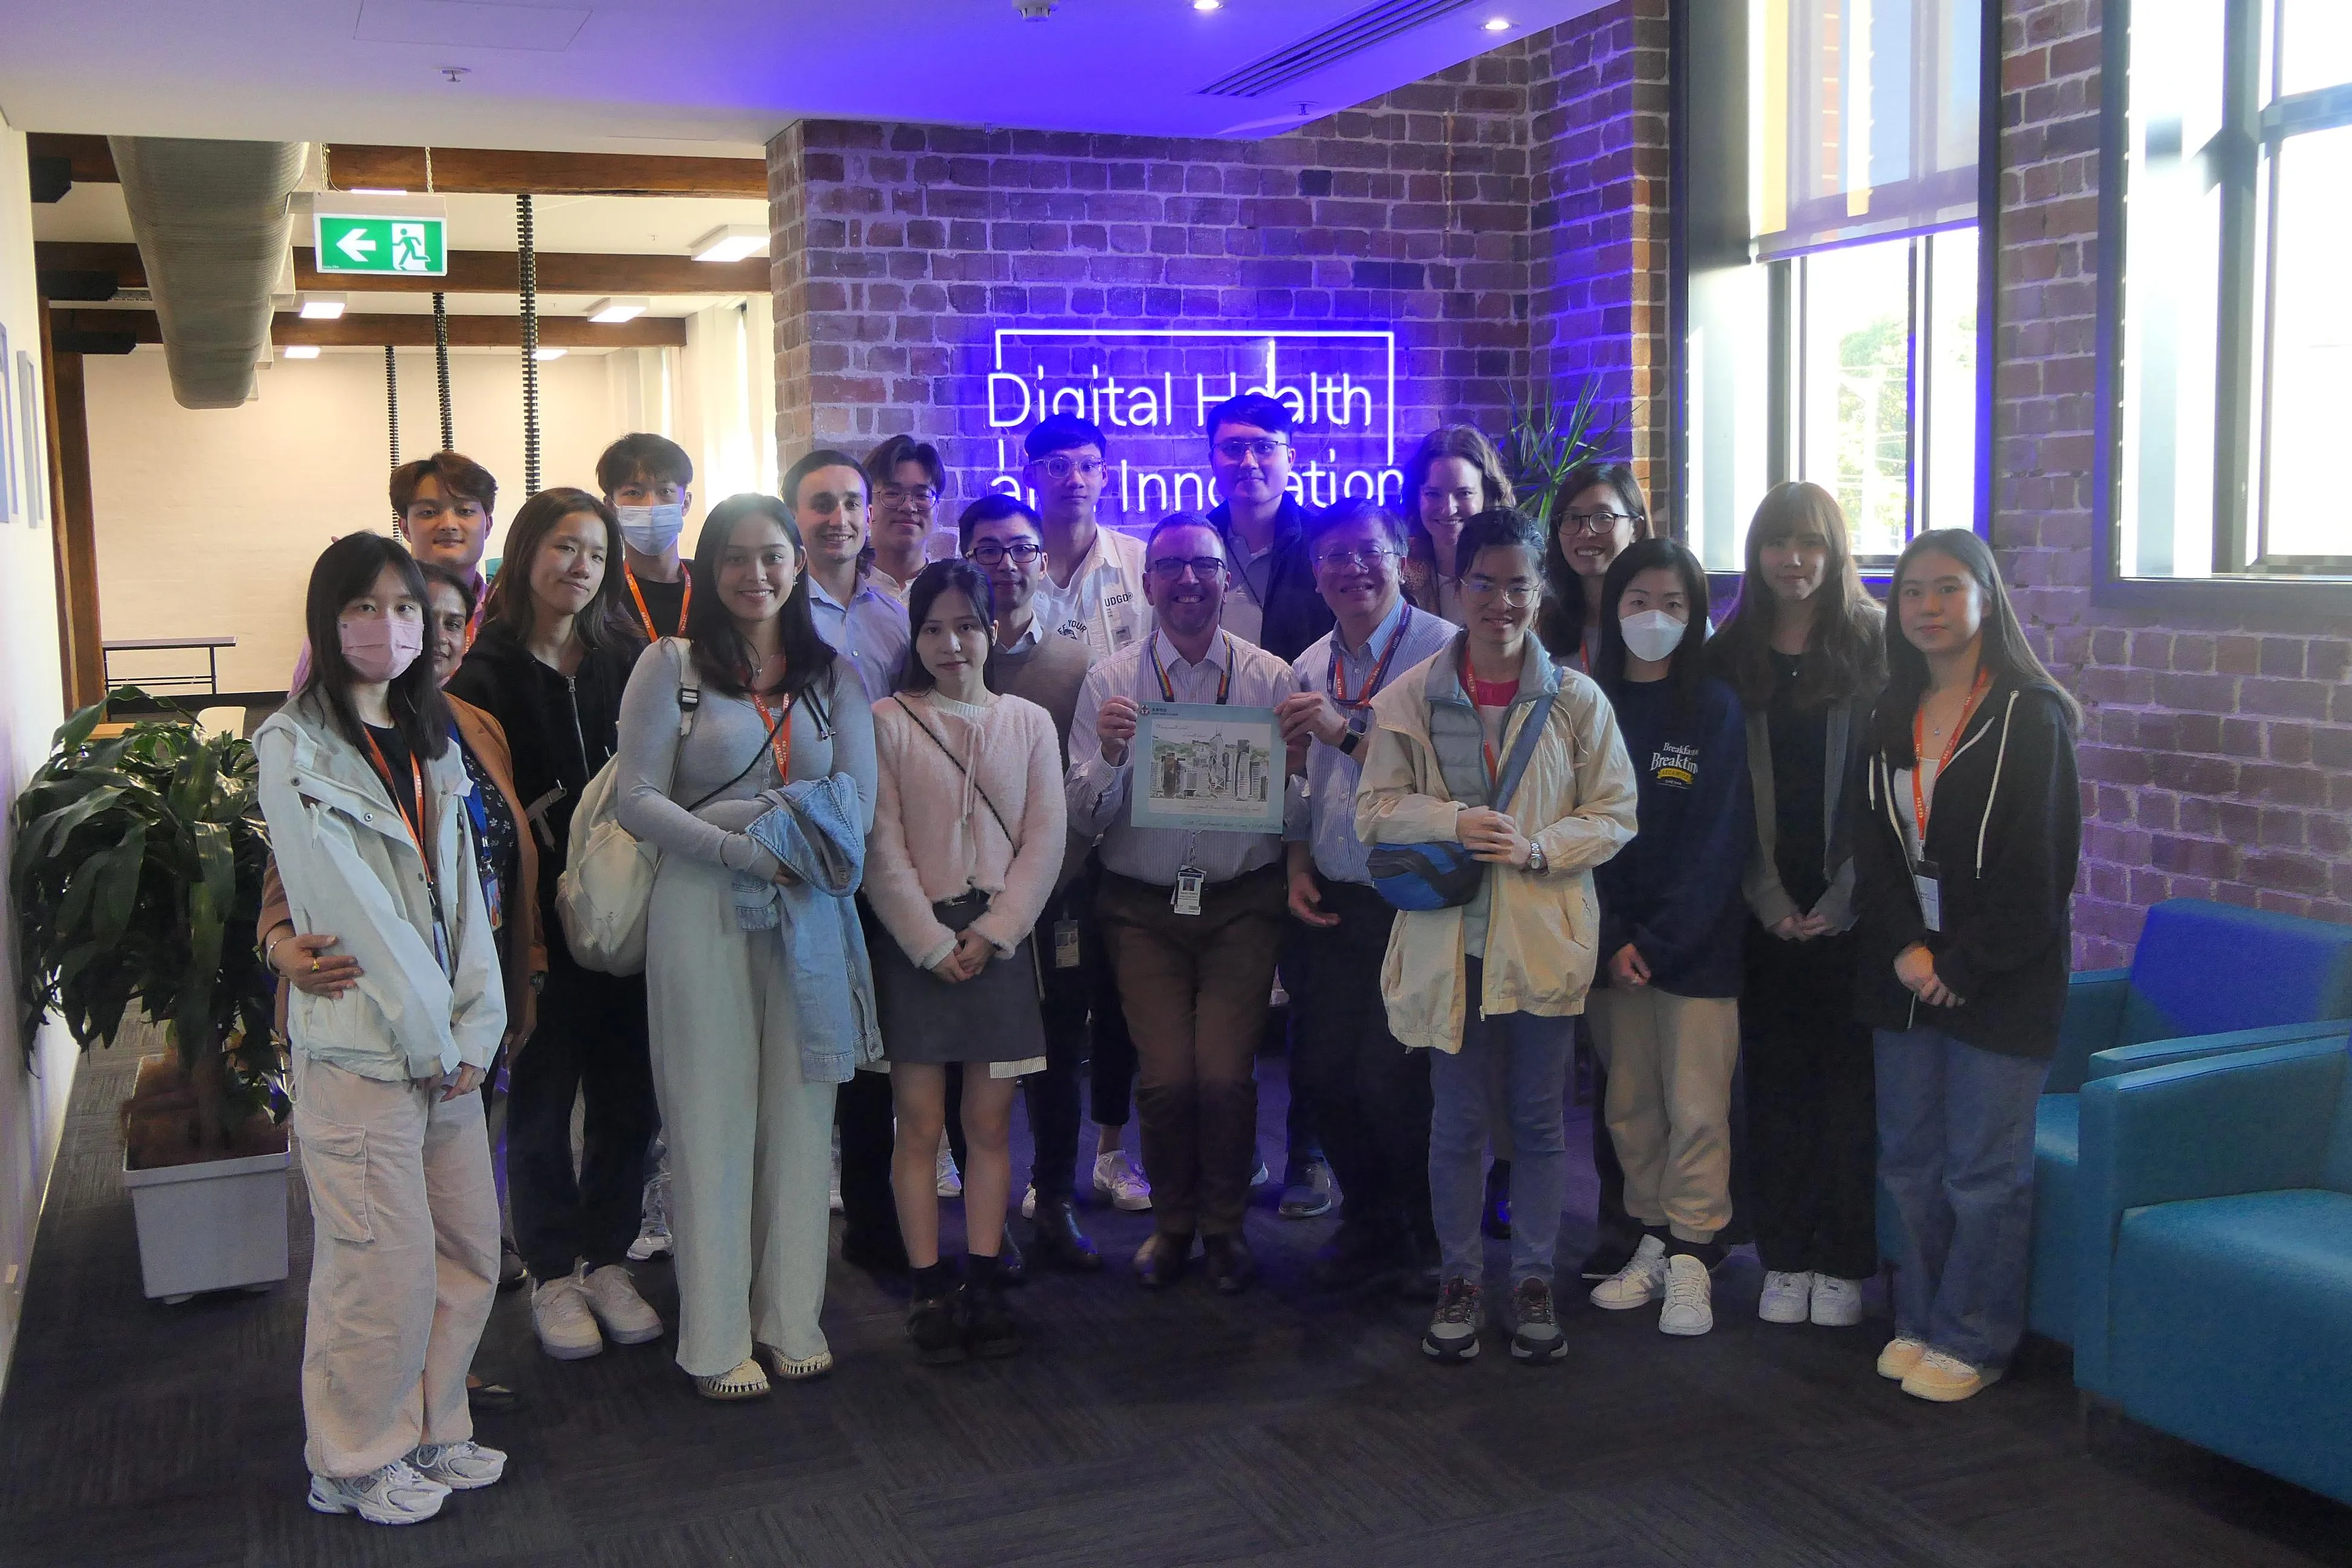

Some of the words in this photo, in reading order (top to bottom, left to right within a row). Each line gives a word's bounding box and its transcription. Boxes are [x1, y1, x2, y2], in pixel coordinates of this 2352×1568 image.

[1197, 372, 1372, 426] Halth
[1120, 448, 1403, 512] Innation
[1068, 619, 1087, 633] YOUR
